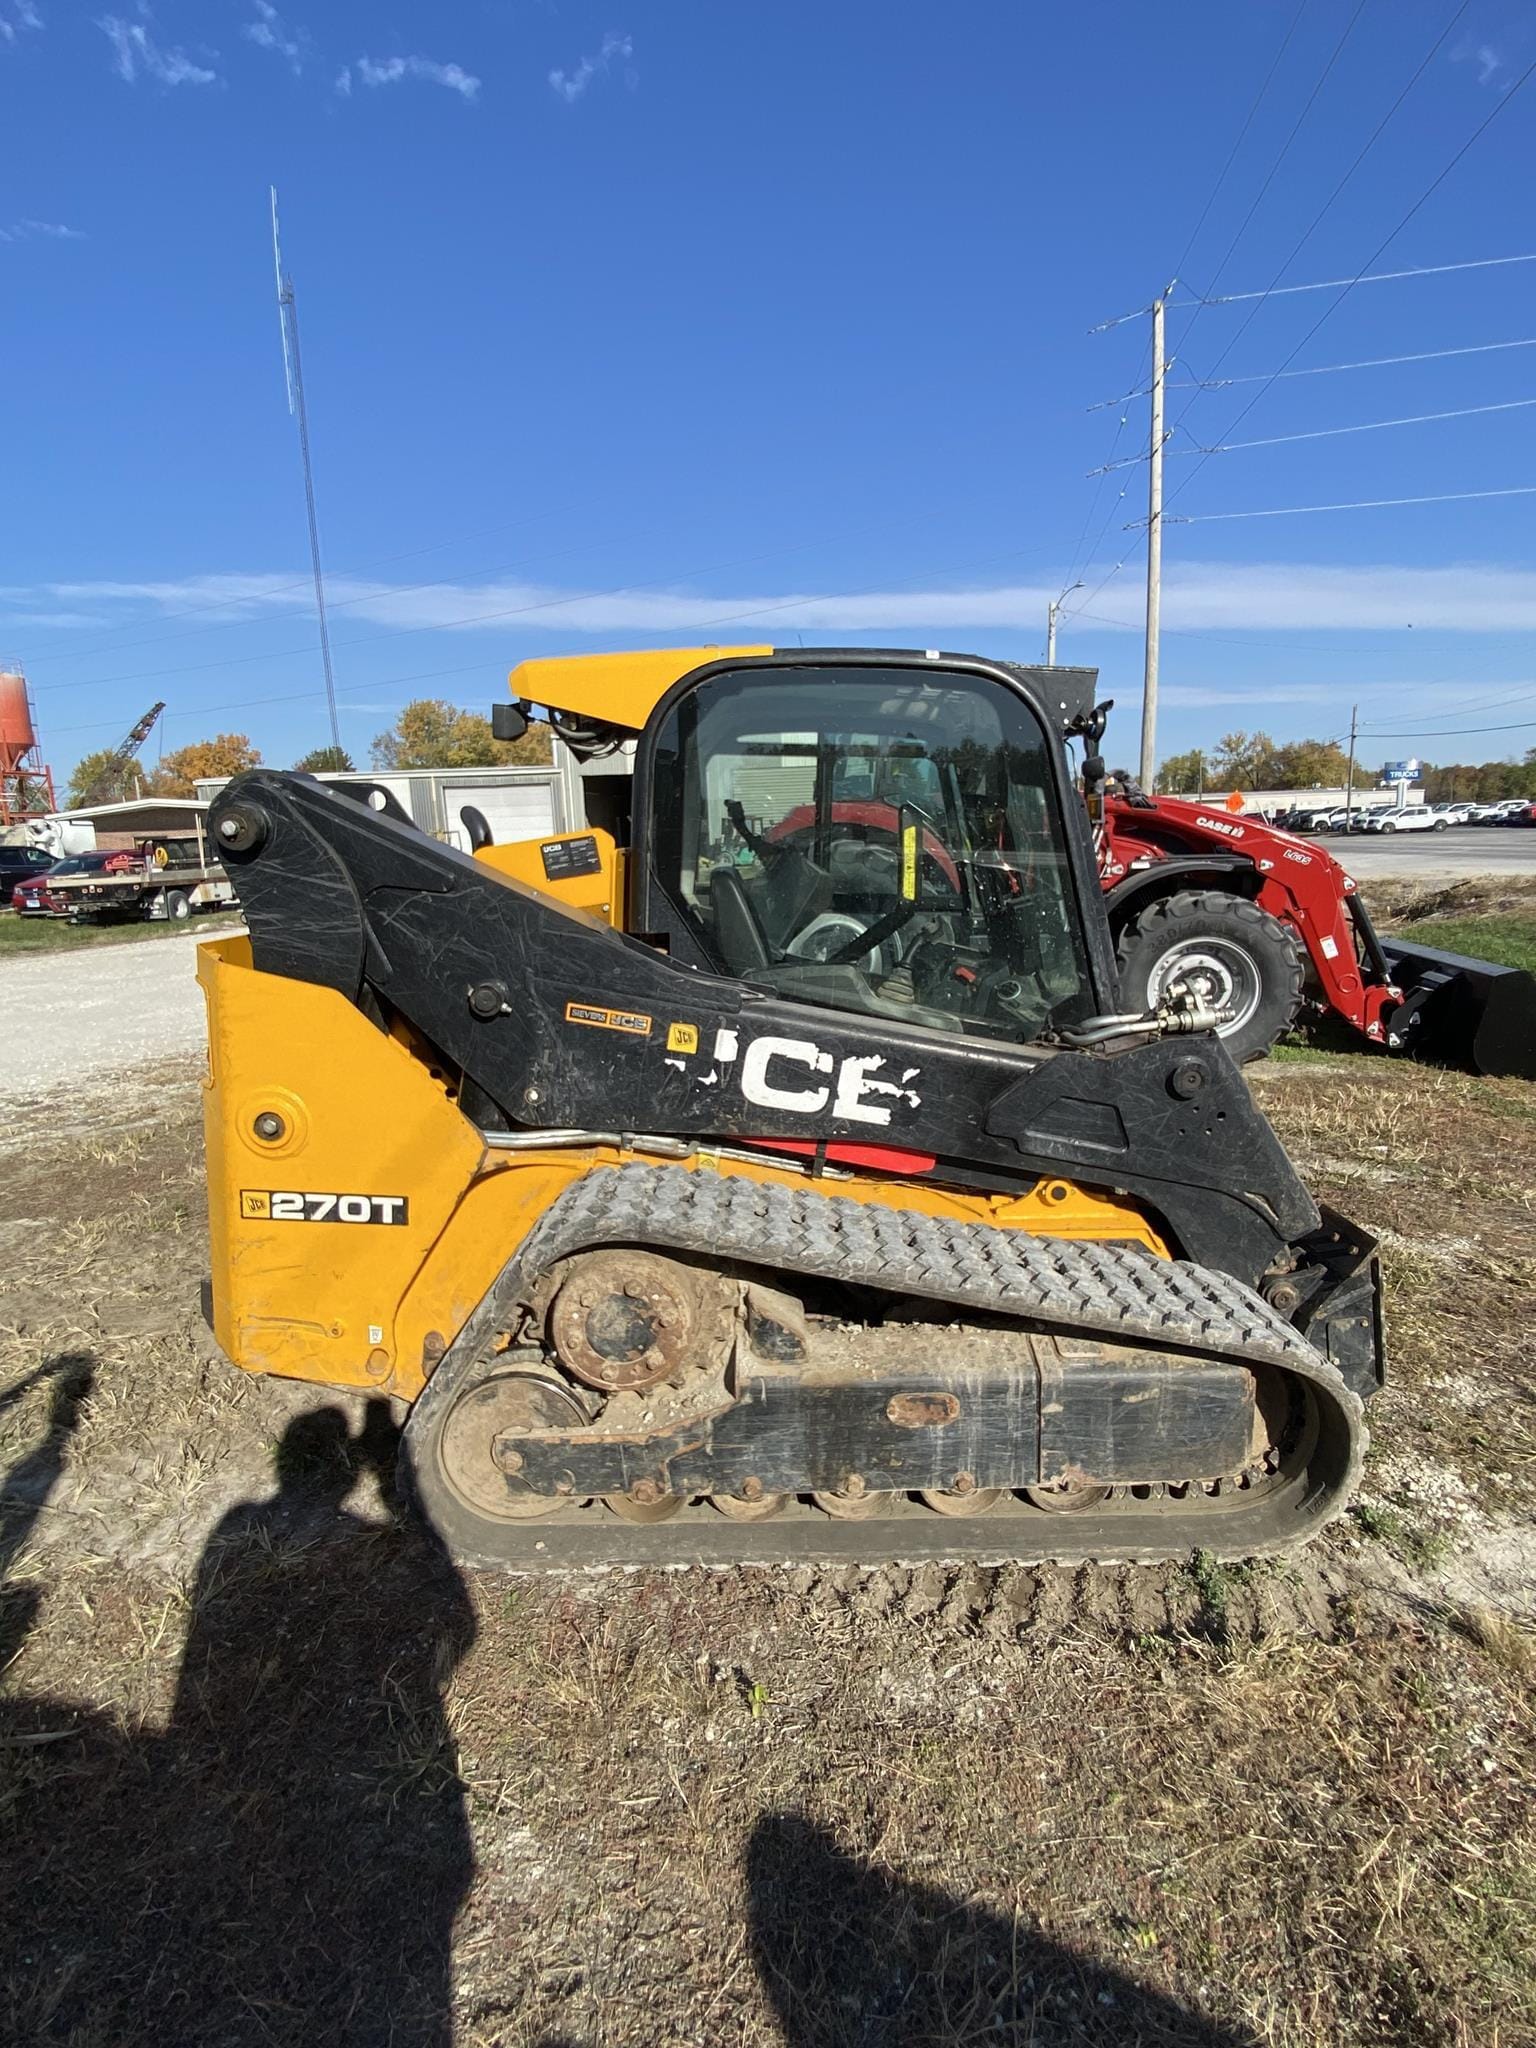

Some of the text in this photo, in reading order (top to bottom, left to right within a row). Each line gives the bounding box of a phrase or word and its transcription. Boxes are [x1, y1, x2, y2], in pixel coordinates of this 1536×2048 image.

[1196, 816, 1233, 834] CASE
[571, 1008, 606, 1022] SIEVERS
[248, 1196, 266, 1212] JCB
[272, 1192, 404, 1224] 270T
